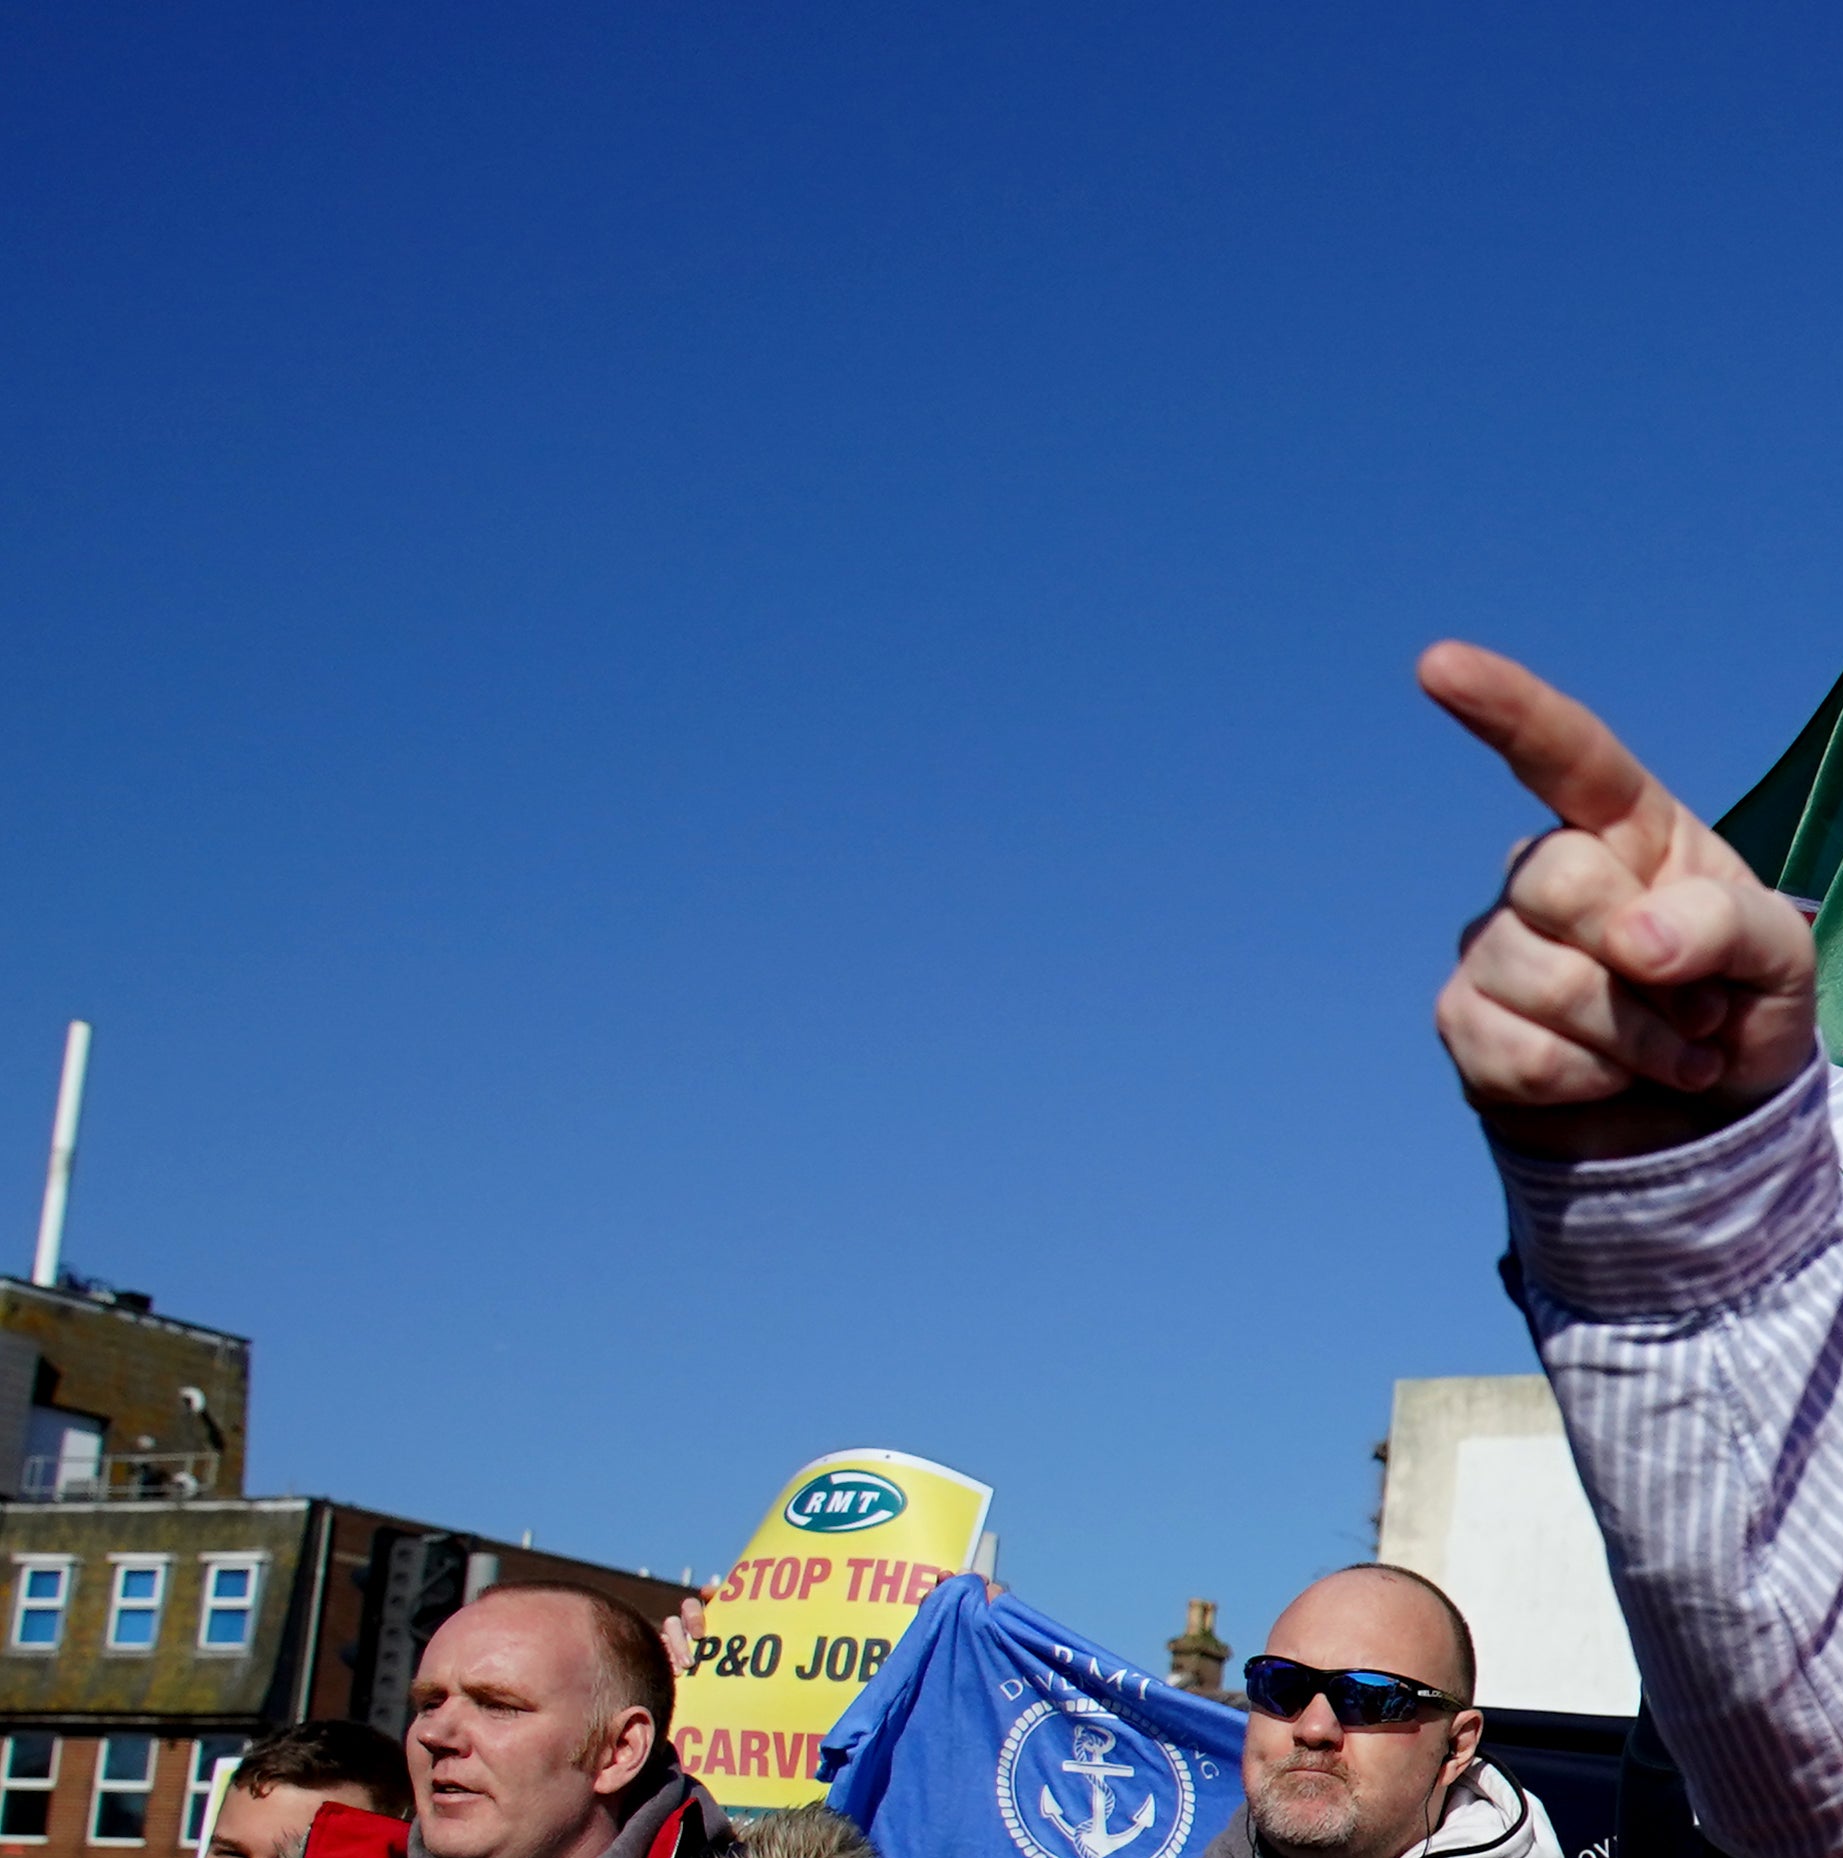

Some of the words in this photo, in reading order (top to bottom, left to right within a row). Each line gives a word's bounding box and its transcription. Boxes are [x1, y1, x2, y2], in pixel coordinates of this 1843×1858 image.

[805, 1490, 880, 1514] RMT
[719, 1556, 832, 1603] STOP
[846, 1557, 941, 1606] THE
[686, 1633, 783, 1678] P&O
[795, 1636, 891, 1683] JOB
